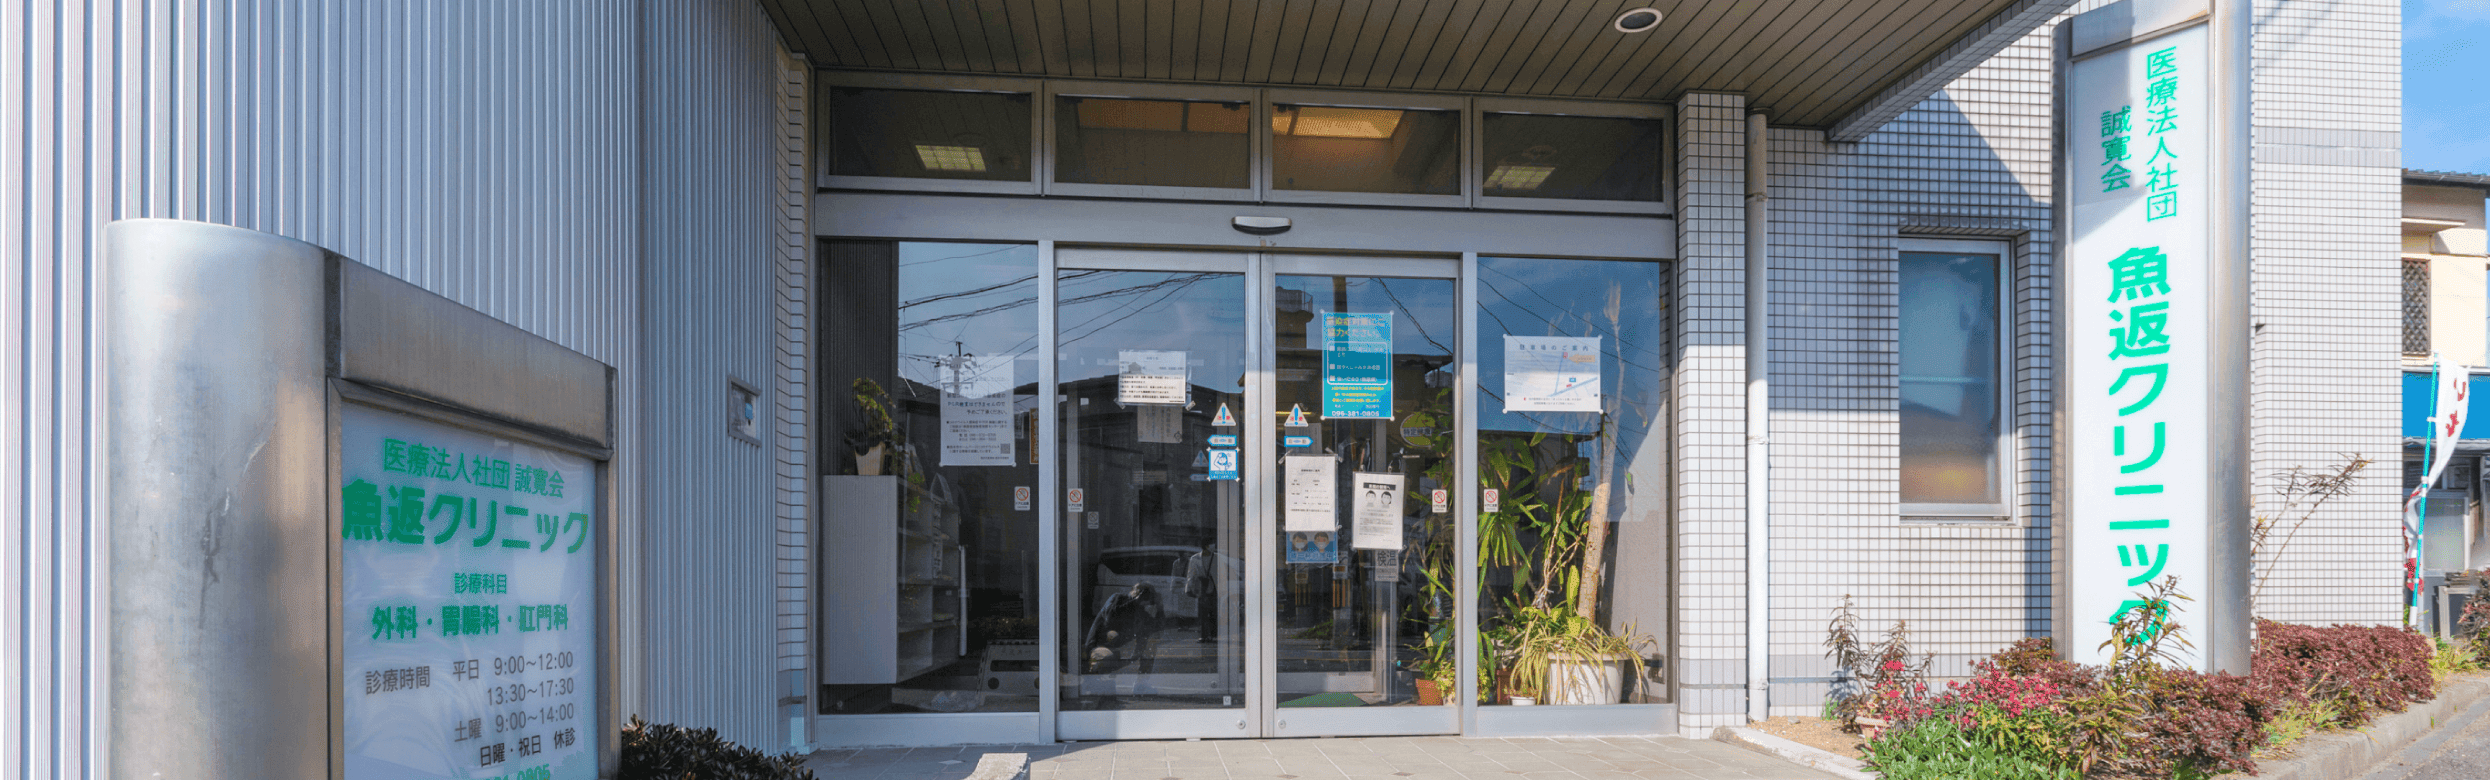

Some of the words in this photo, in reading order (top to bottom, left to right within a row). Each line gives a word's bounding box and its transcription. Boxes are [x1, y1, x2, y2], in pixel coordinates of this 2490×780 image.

[2146, 46, 2178, 222] 医療法人社団
[383, 437, 511, 491] 医療法人社団
[2107, 246, 2172, 646] 魚返クリニック
[341, 478, 589, 554] 魚返クリニック
[454, 573, 508, 595] 診療科目
[365, 666, 430, 696] 診療時間
[453, 659, 480, 682] 平日
[454, 718, 482, 743] 土曜
[480, 735, 541, 767] 日曜・祝日
[553, 727, 576, 750] 休診
